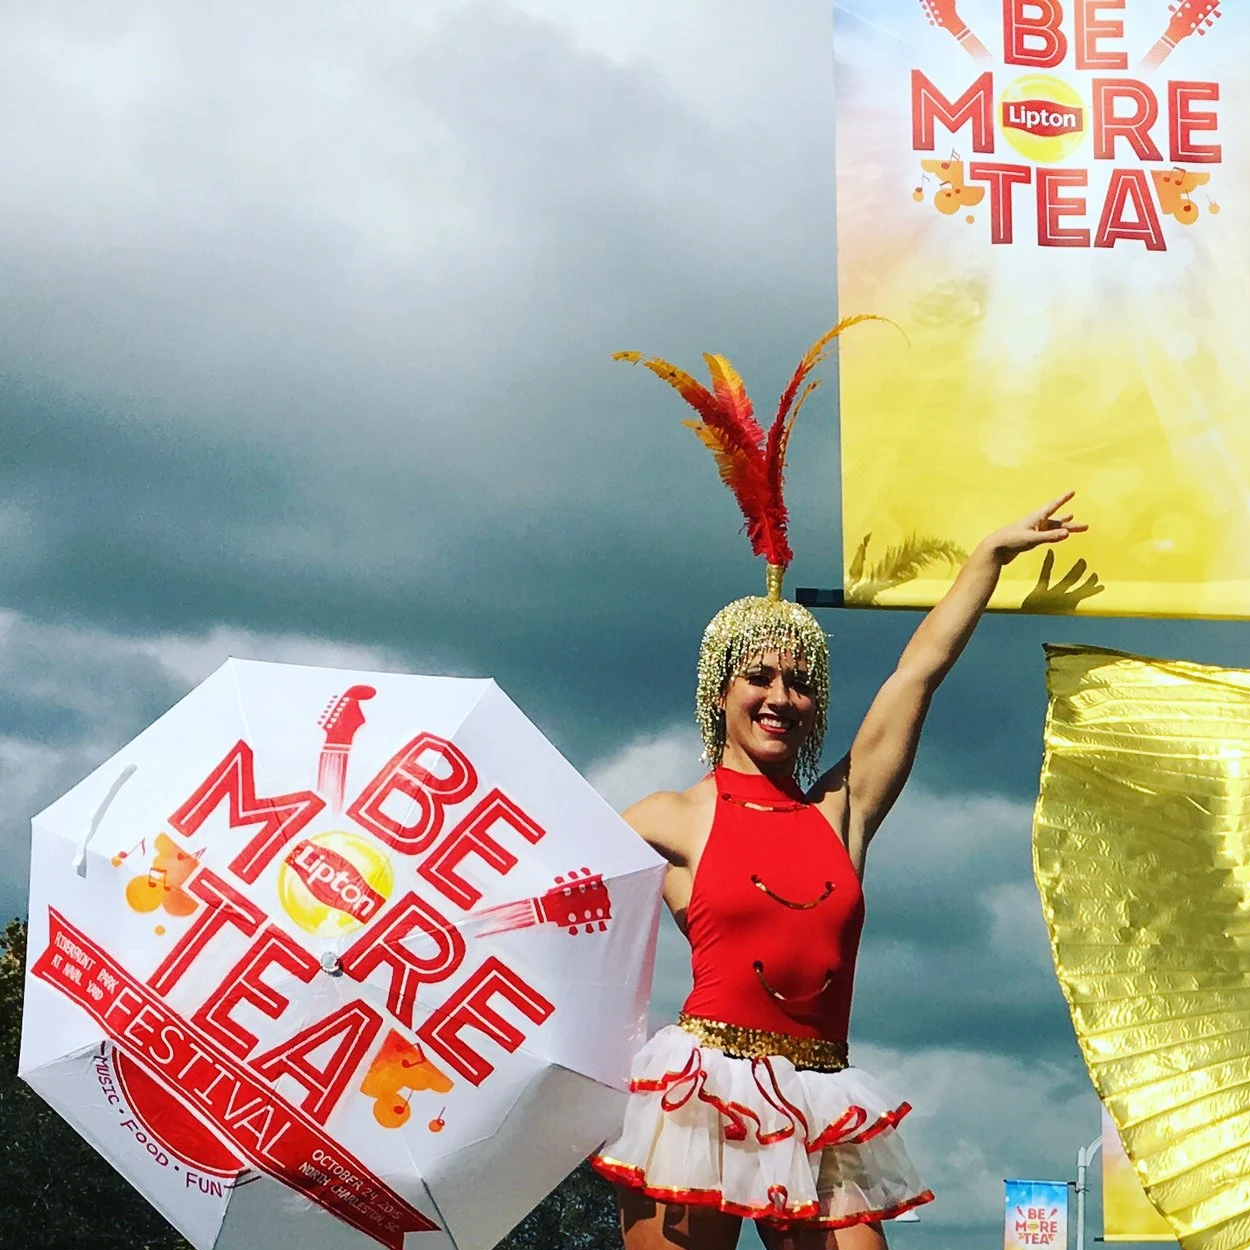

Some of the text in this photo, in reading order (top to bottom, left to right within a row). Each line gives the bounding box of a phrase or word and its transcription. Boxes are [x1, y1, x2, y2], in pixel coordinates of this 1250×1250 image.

[1003, 0, 1128, 70] BE
[1009, 104, 1077, 129] Lipton
[969, 161, 1168, 252] TEA
[345, 731, 547, 911] BE
[294, 845, 376, 917] Lipton
[145, 867, 384, 1128] TEA
[104, 986, 287, 1169] FESTIVAL
[95, 1056, 223, 1198] MUSIC FOOD FUN
[299, 1162, 332, 1186] NORTH
[312, 1149, 364, 1191] OCTOBER
[1024, 1233, 1049, 1245] TEA
[1027, 1208, 1045, 1220] BE
